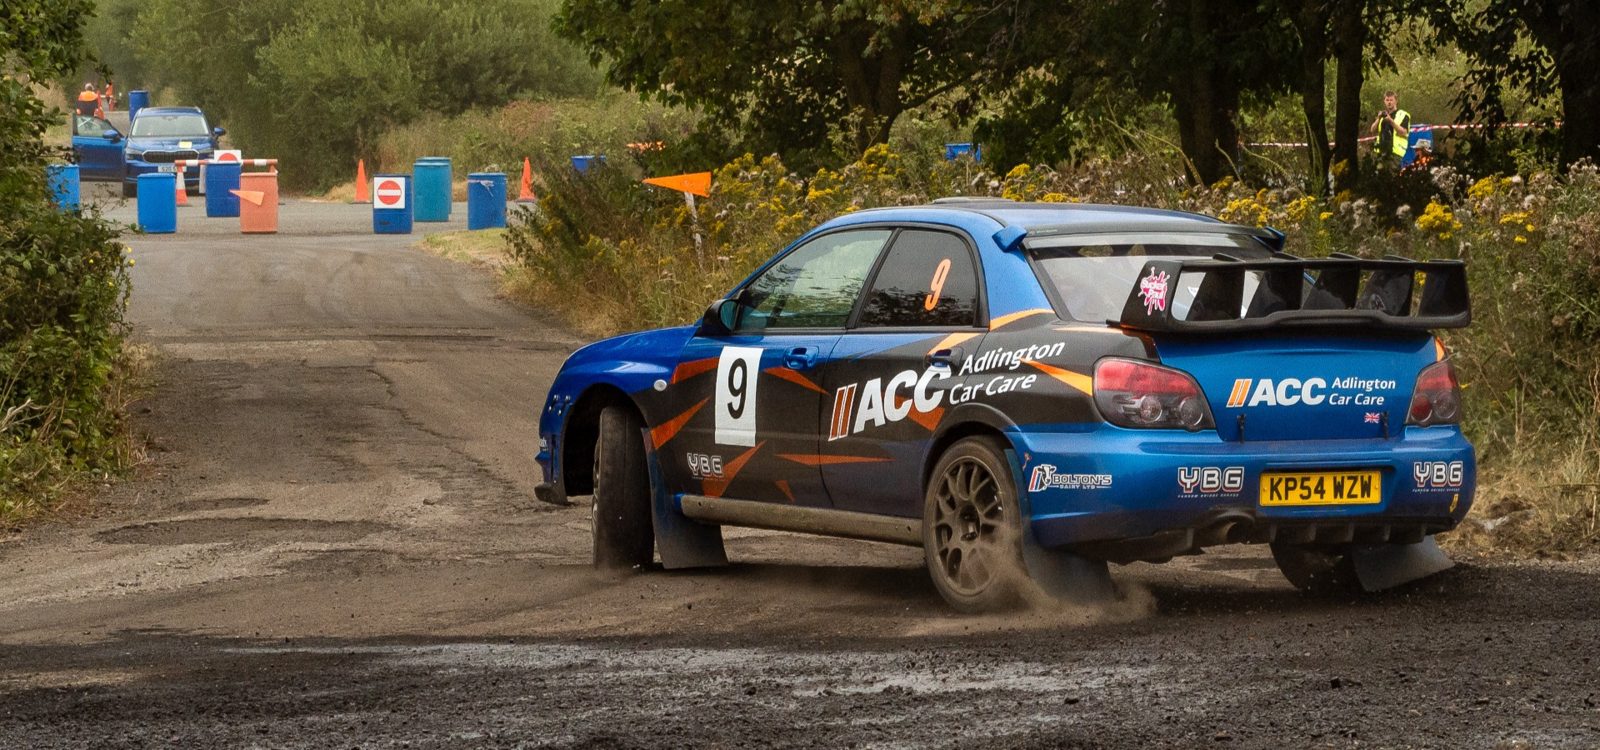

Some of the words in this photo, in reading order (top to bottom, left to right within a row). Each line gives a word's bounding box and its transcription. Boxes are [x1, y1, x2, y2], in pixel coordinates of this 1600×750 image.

[925, 259, 952, 310] 9
[958, 342, 1066, 377] Adlington
[727, 357, 748, 420] 9
[950, 383, 985, 405] Car
[985, 374, 1038, 397] Care
[1247, 377, 1327, 407] ACC
[1331, 377, 1397, 392] Adlington
[853, 364, 952, 434] ACC
[1329, 393, 1352, 406] Car
[1354, 393, 1385, 406] Care
[686, 452, 725, 478] YBG
[1413, 460, 1464, 488] YBG
[1052, 474, 1113, 486] BOLTON'S
[1177, 466, 1245, 494] YBG
[1269, 476, 1326, 501] KP54
[1332, 475, 1372, 499] WZW
